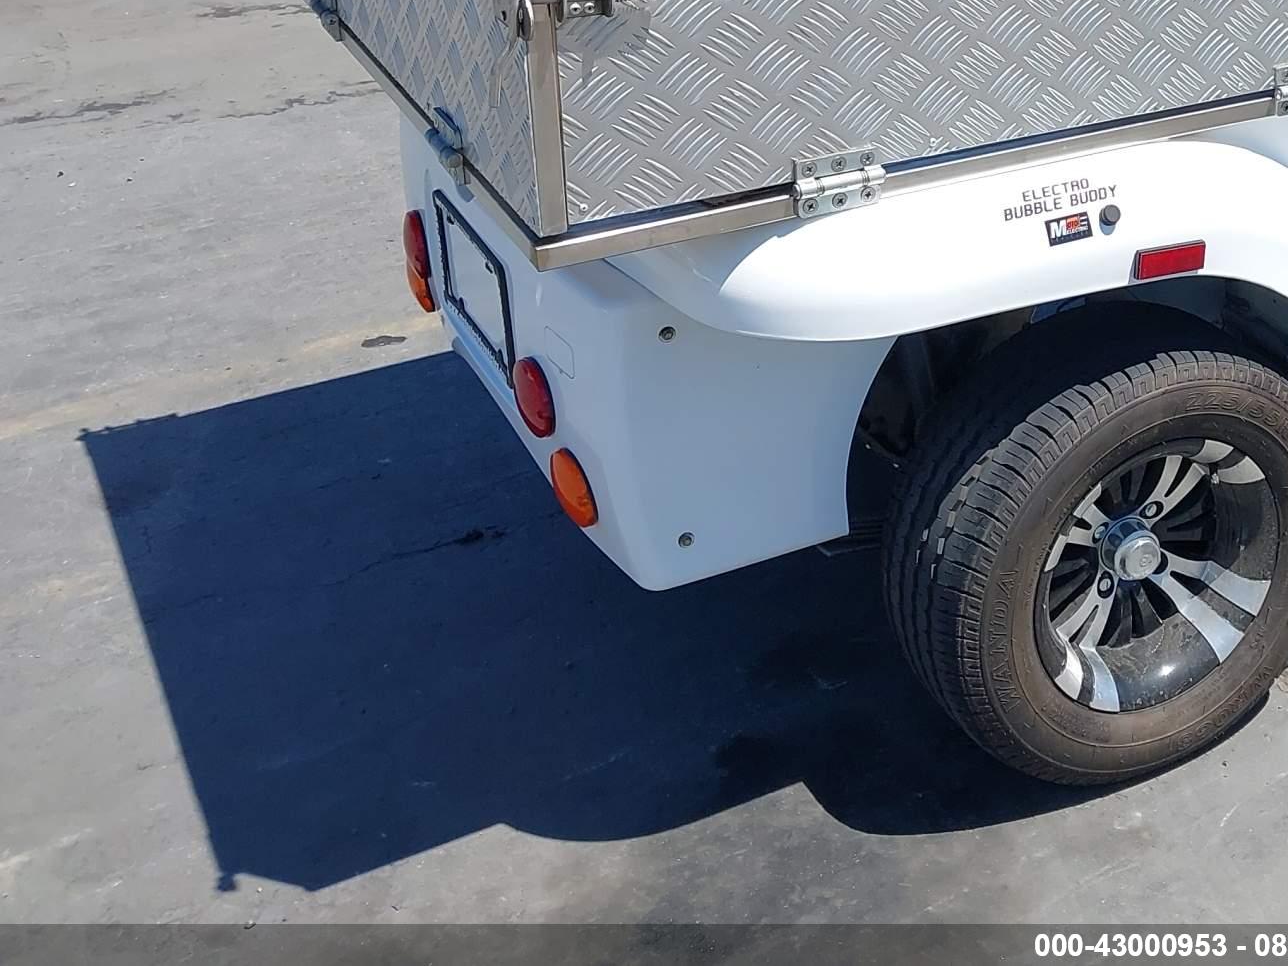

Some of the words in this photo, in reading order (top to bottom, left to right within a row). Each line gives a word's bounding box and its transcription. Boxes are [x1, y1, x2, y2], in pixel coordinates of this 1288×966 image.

[1004, 197, 1062, 221] BUBBLE
[1070, 185, 1117, 206] BUDDY
[1022, 178, 1089, 202] ELECTRO
[990, 569, 1021, 713] WANDA
